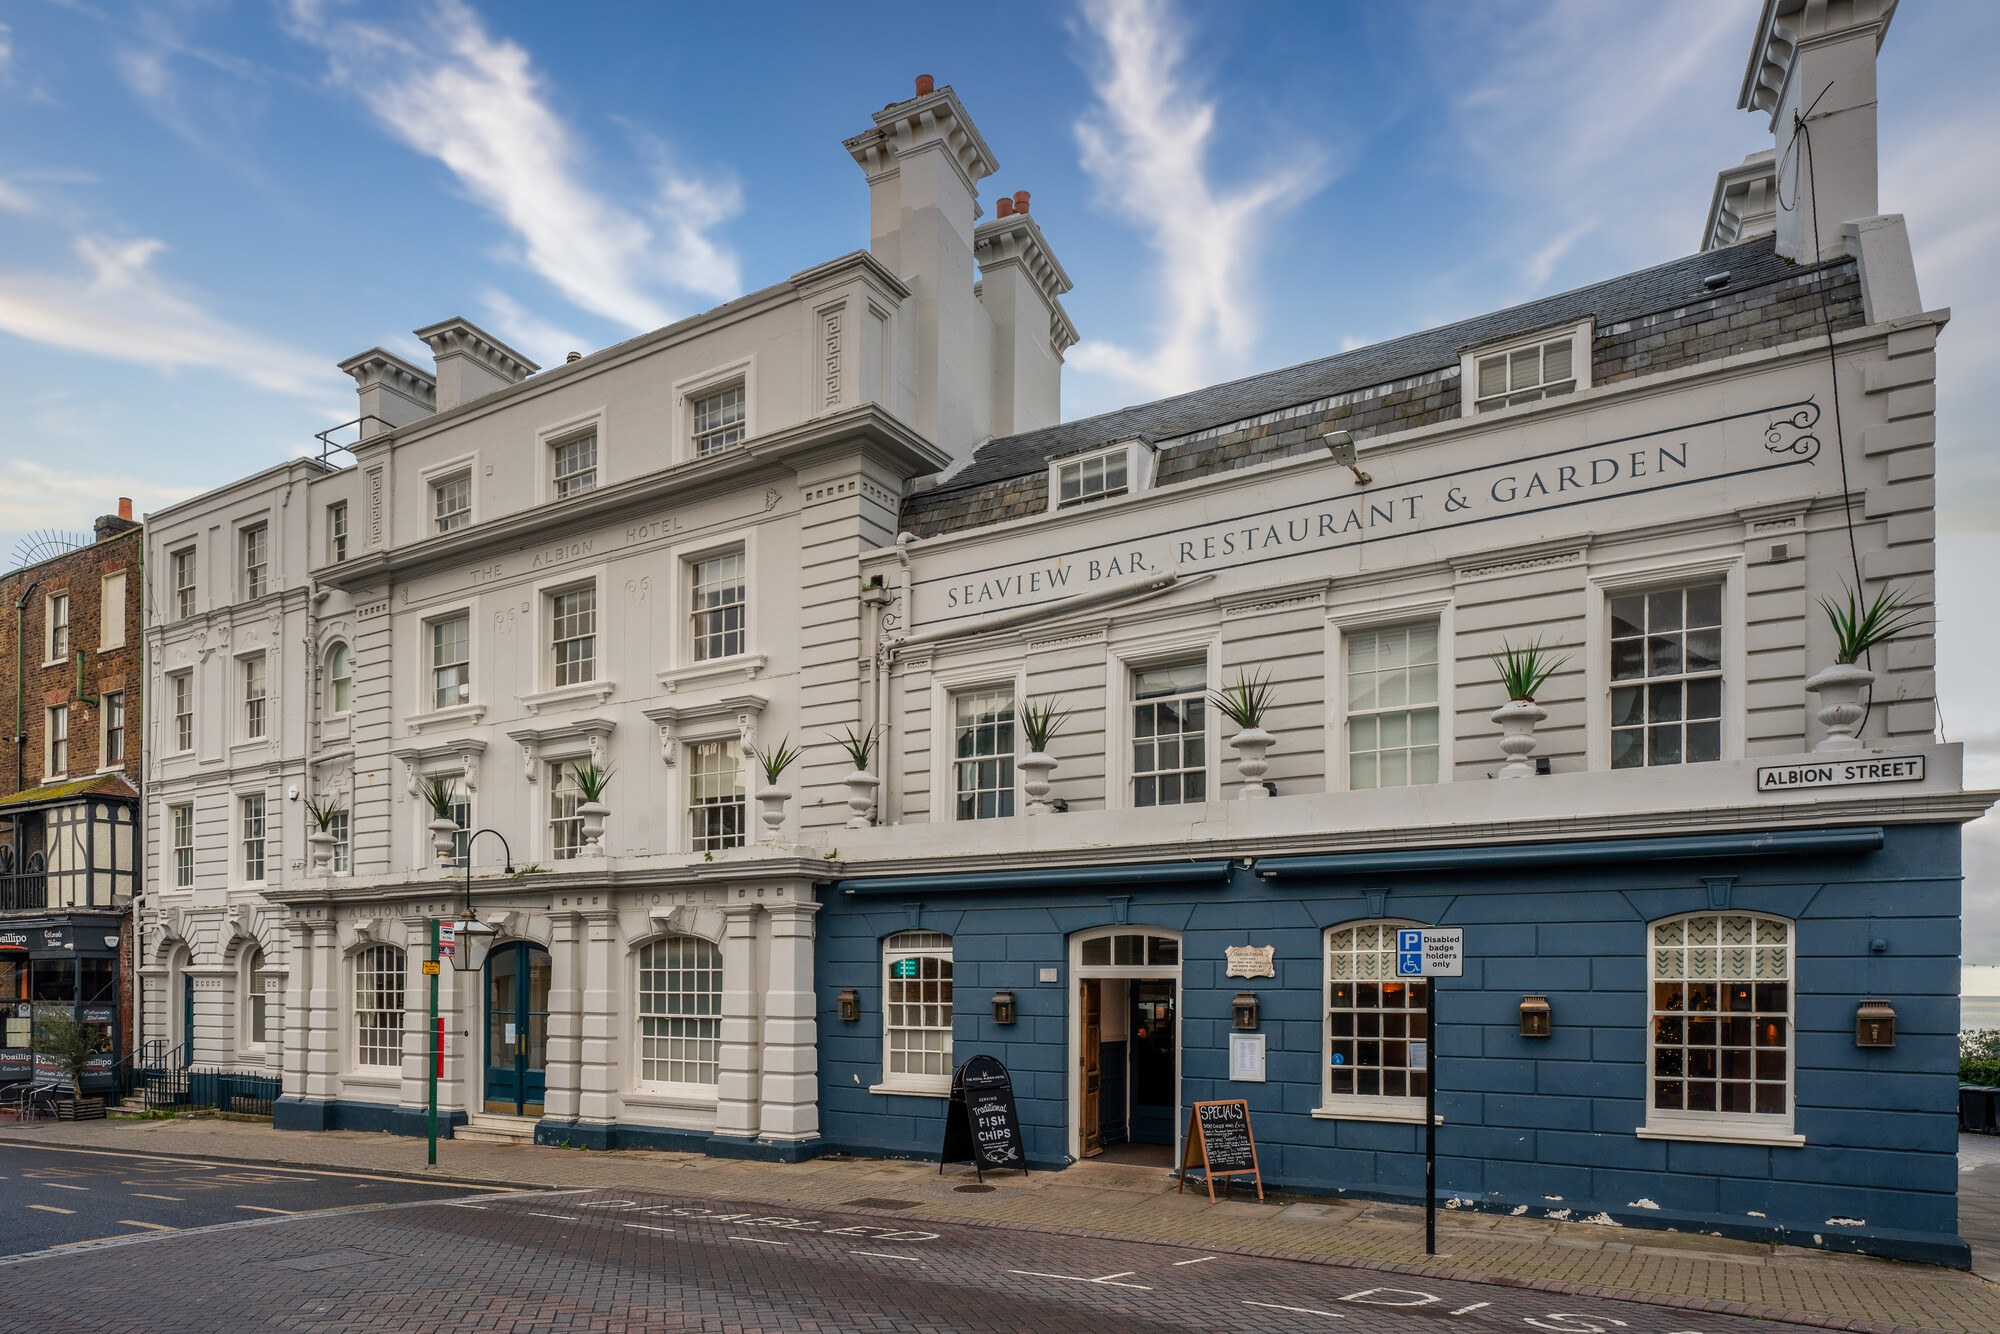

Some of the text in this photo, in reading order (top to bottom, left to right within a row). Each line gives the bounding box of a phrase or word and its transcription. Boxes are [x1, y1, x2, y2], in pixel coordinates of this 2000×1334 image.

[947, 441, 1689, 609] SEAVIEW BAR, RESTAURANT & GARDEN
[470, 517, 684, 584] THE ALBION HOTEL
[1765, 761, 1918, 786] ALBION STREET
[349, 889, 714, 918] ALBION HOTEL
[1405, 933, 1419, 950] P
[1429, 944, 1454, 952] badge
[1432, 961, 1450, 969] only
[86, 1058, 112, 1067] osillipo
[972, 1103, 1008, 1116] Traditional
[1200, 1103, 1243, 1120] SPECIALS
[979, 1115, 1006, 1127] FISH
[978, 1128, 1011, 1141] CHIPS
[576, 1200, 941, 1241] DISABLED
[1337, 1287, 1704, 1334] DIS
